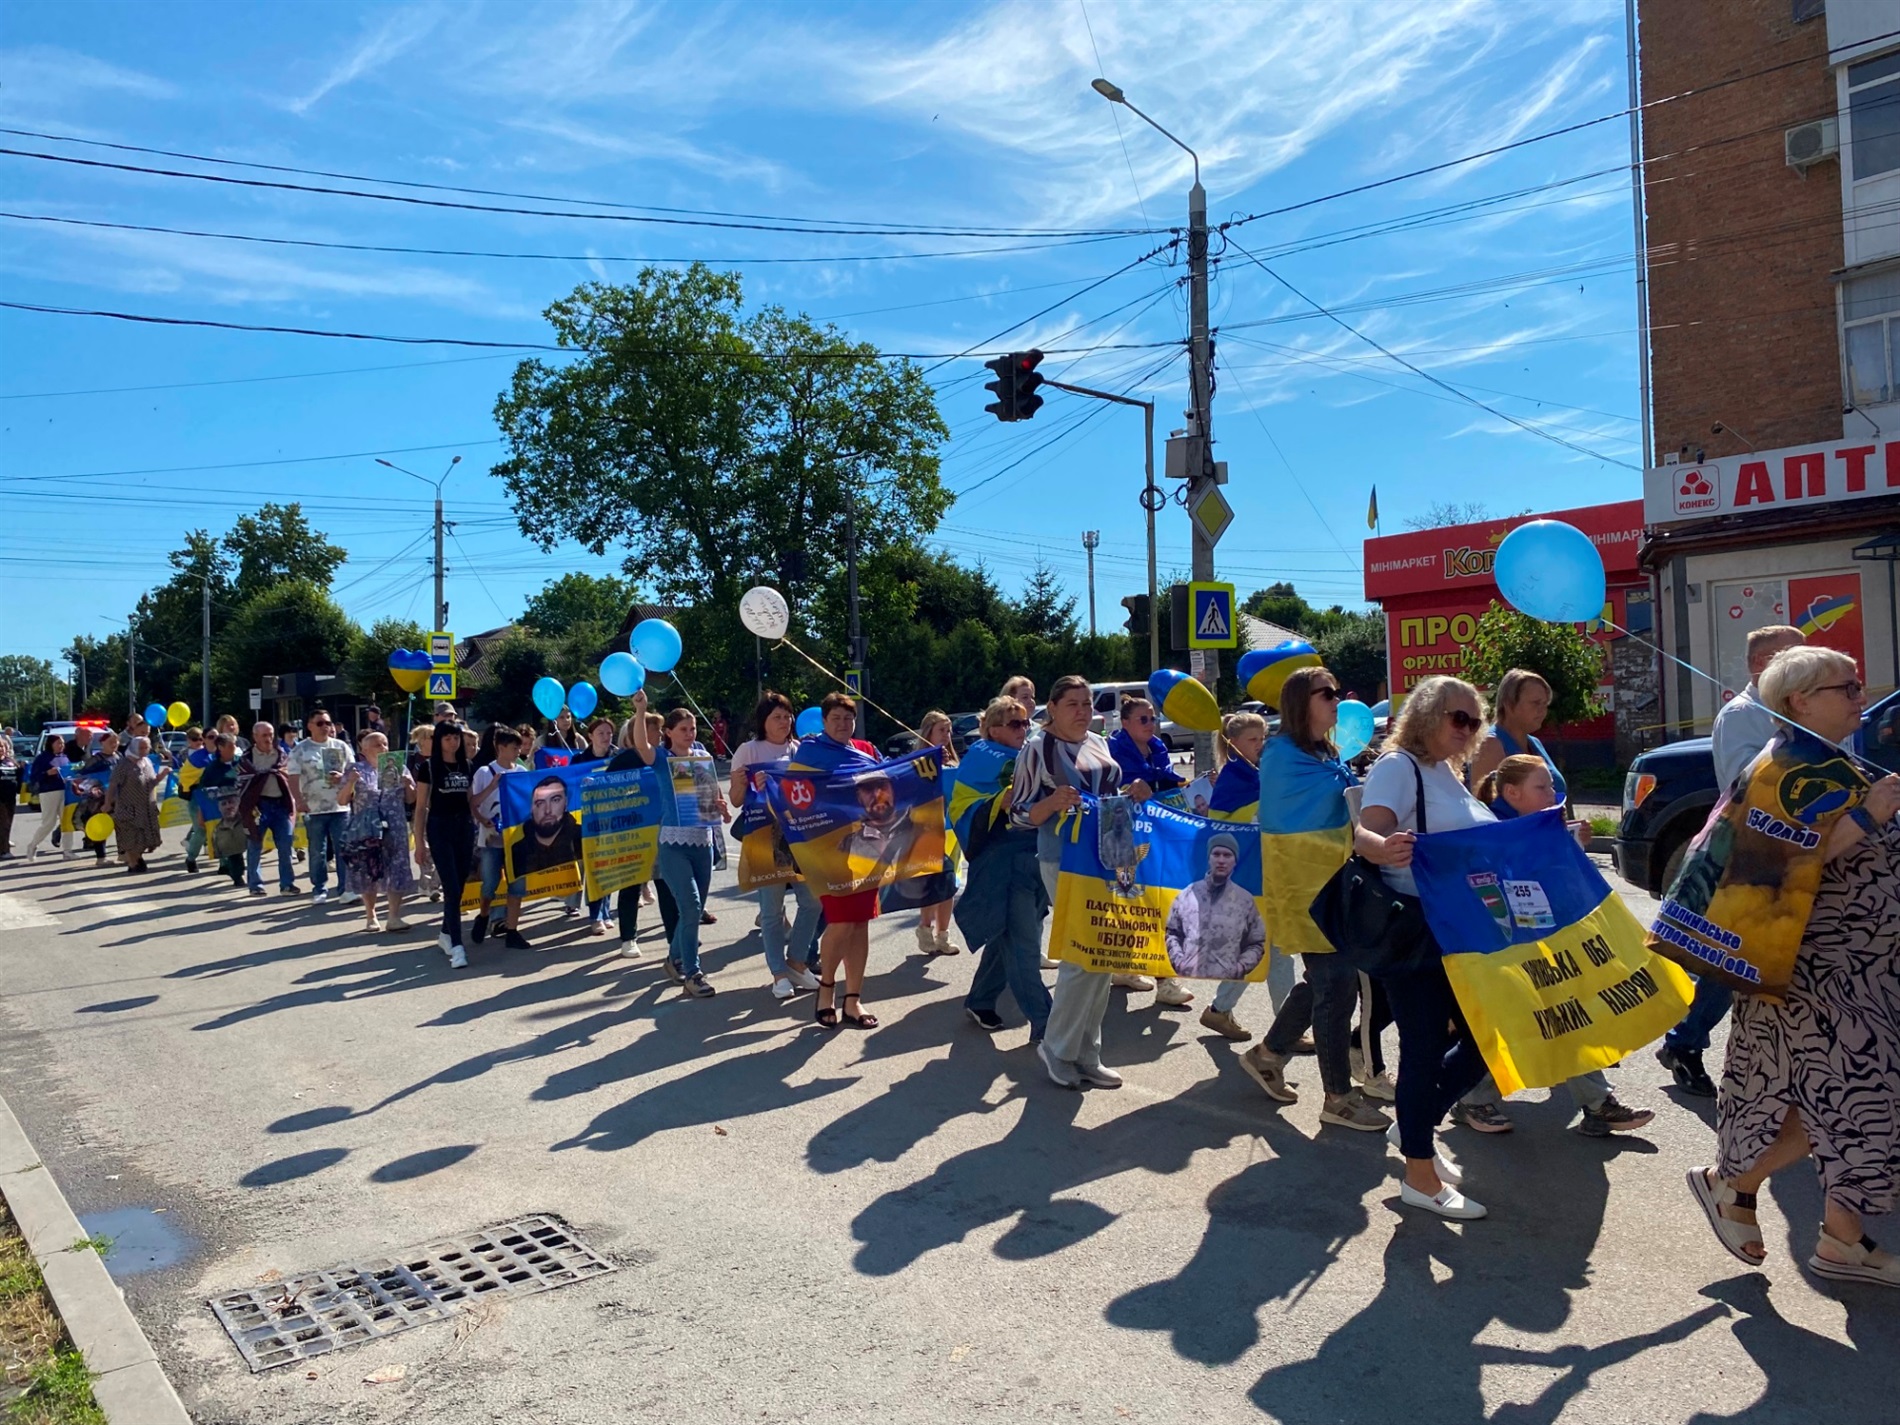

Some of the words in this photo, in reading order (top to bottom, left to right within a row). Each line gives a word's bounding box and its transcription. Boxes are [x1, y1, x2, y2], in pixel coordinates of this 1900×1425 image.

[1679, 498, 1715, 509] КОНЕКС
[1370, 555, 1437, 573] МІНІМАРКЕТ
[1146, 804, 1206, 829] ВІРИМО
[1747, 808, 1772, 831] 154
[1513, 885, 1532, 898] 255
[1086, 899, 1127, 915] ПАСТУХ
[1129, 905, 1161, 918] СЕРГІЙ
[1597, 966, 1660, 1016] НАПРЯМ
